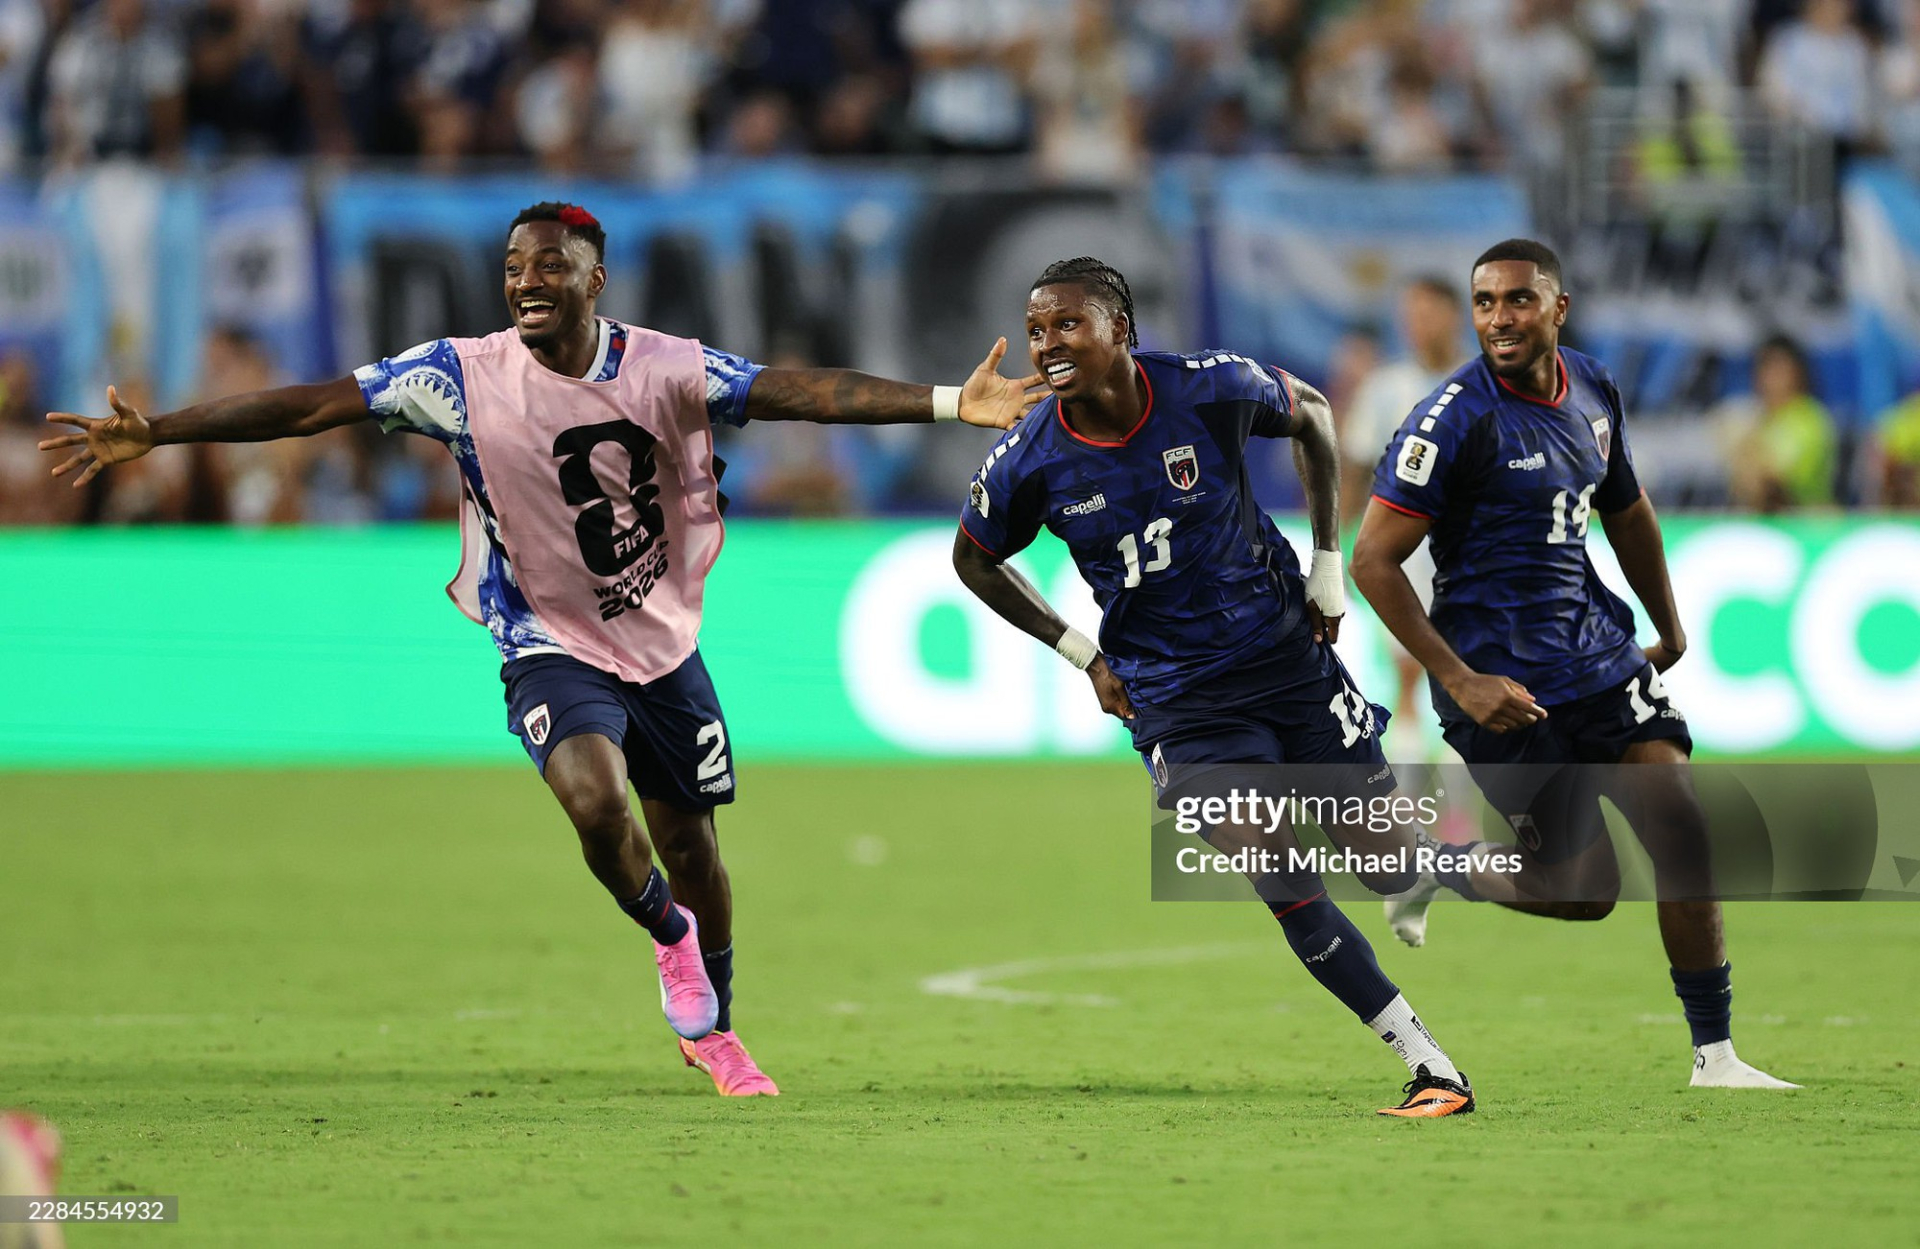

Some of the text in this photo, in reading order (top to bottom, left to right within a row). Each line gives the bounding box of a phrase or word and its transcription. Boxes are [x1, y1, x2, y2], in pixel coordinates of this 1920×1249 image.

[1166, 448, 1191, 460] FCF
[1508, 451, 1546, 470] capelli
[1063, 493, 1106, 515] capelli
[1546, 482, 1596, 544] 14
[613, 524, 649, 559] FIFA
[1116, 517, 1173, 589] 13
[593, 562, 646, 599] WORLD
[598, 552, 669, 622] 2026
[696, 719, 727, 780] 2
[700, 773, 732, 794] capelli
